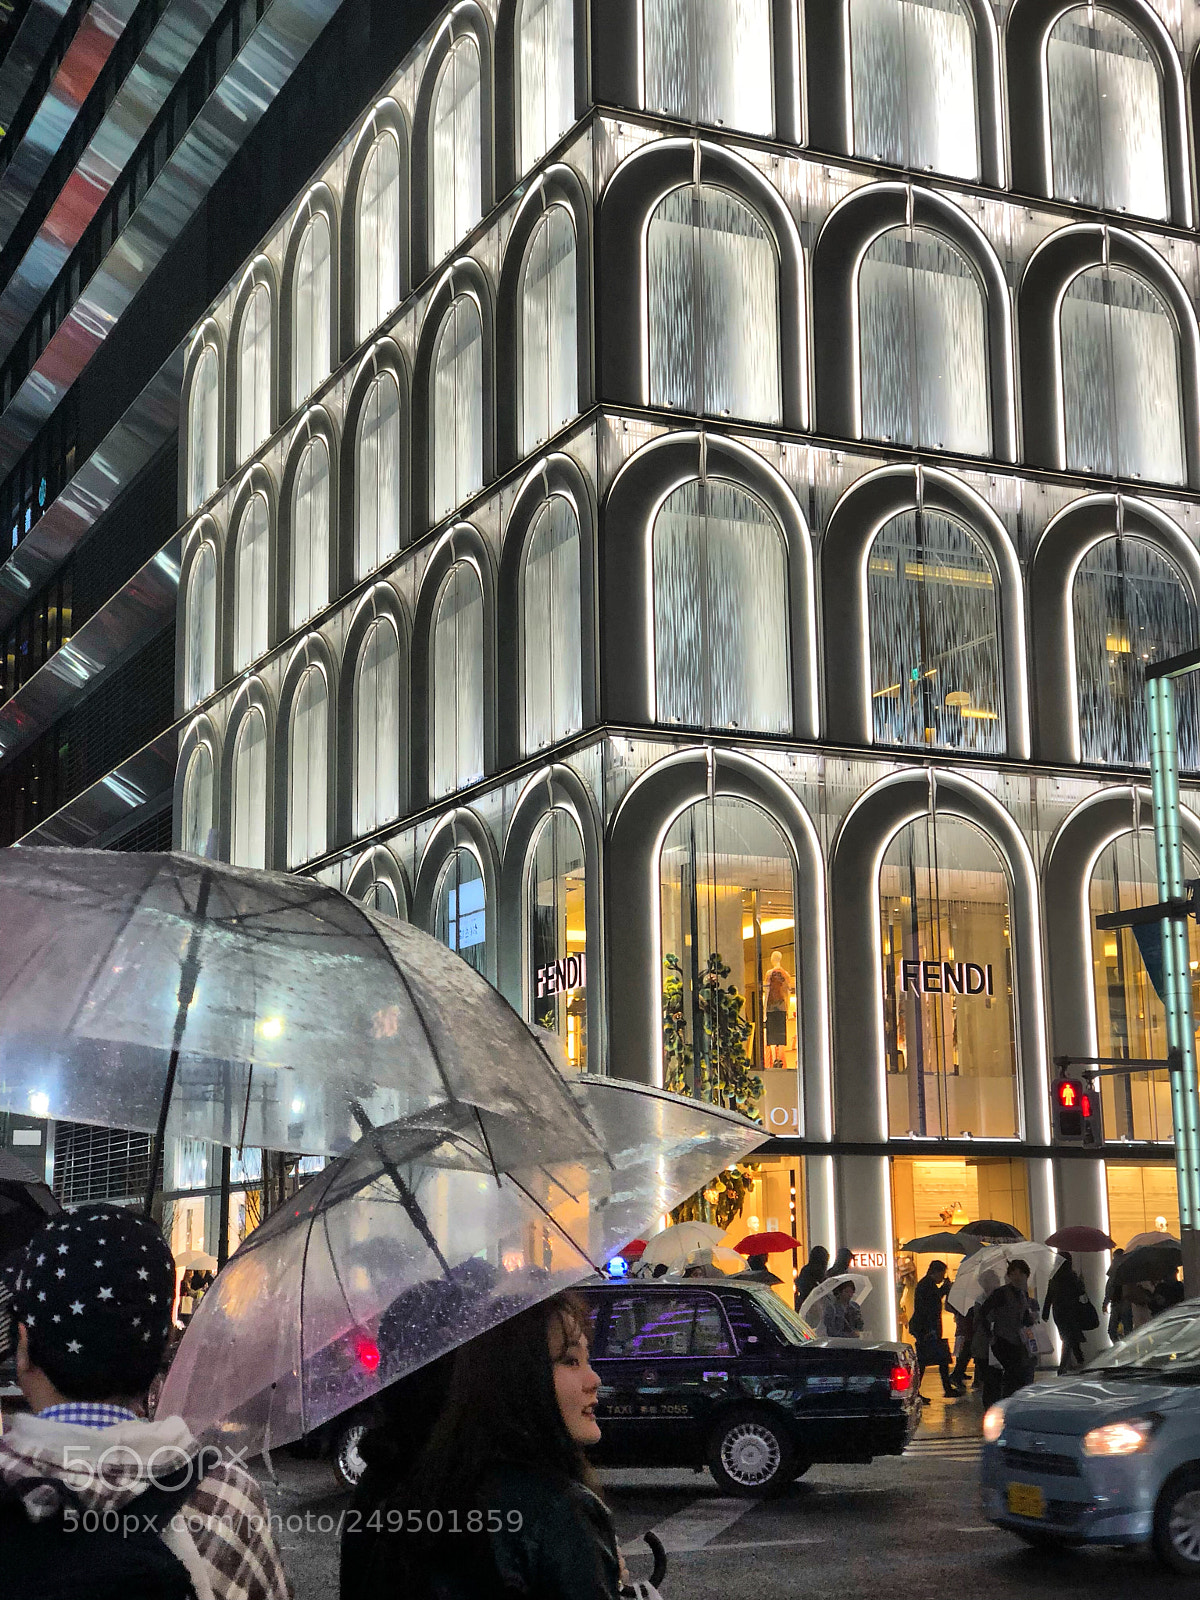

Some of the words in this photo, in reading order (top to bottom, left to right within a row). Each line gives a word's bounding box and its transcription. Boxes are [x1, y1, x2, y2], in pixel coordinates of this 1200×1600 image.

[534, 953, 586, 998] FENDI
[901, 959, 994, 996] FENDI
[851, 1252, 888, 1268] FENDI
[606, 1405, 633, 1415] TAXI
